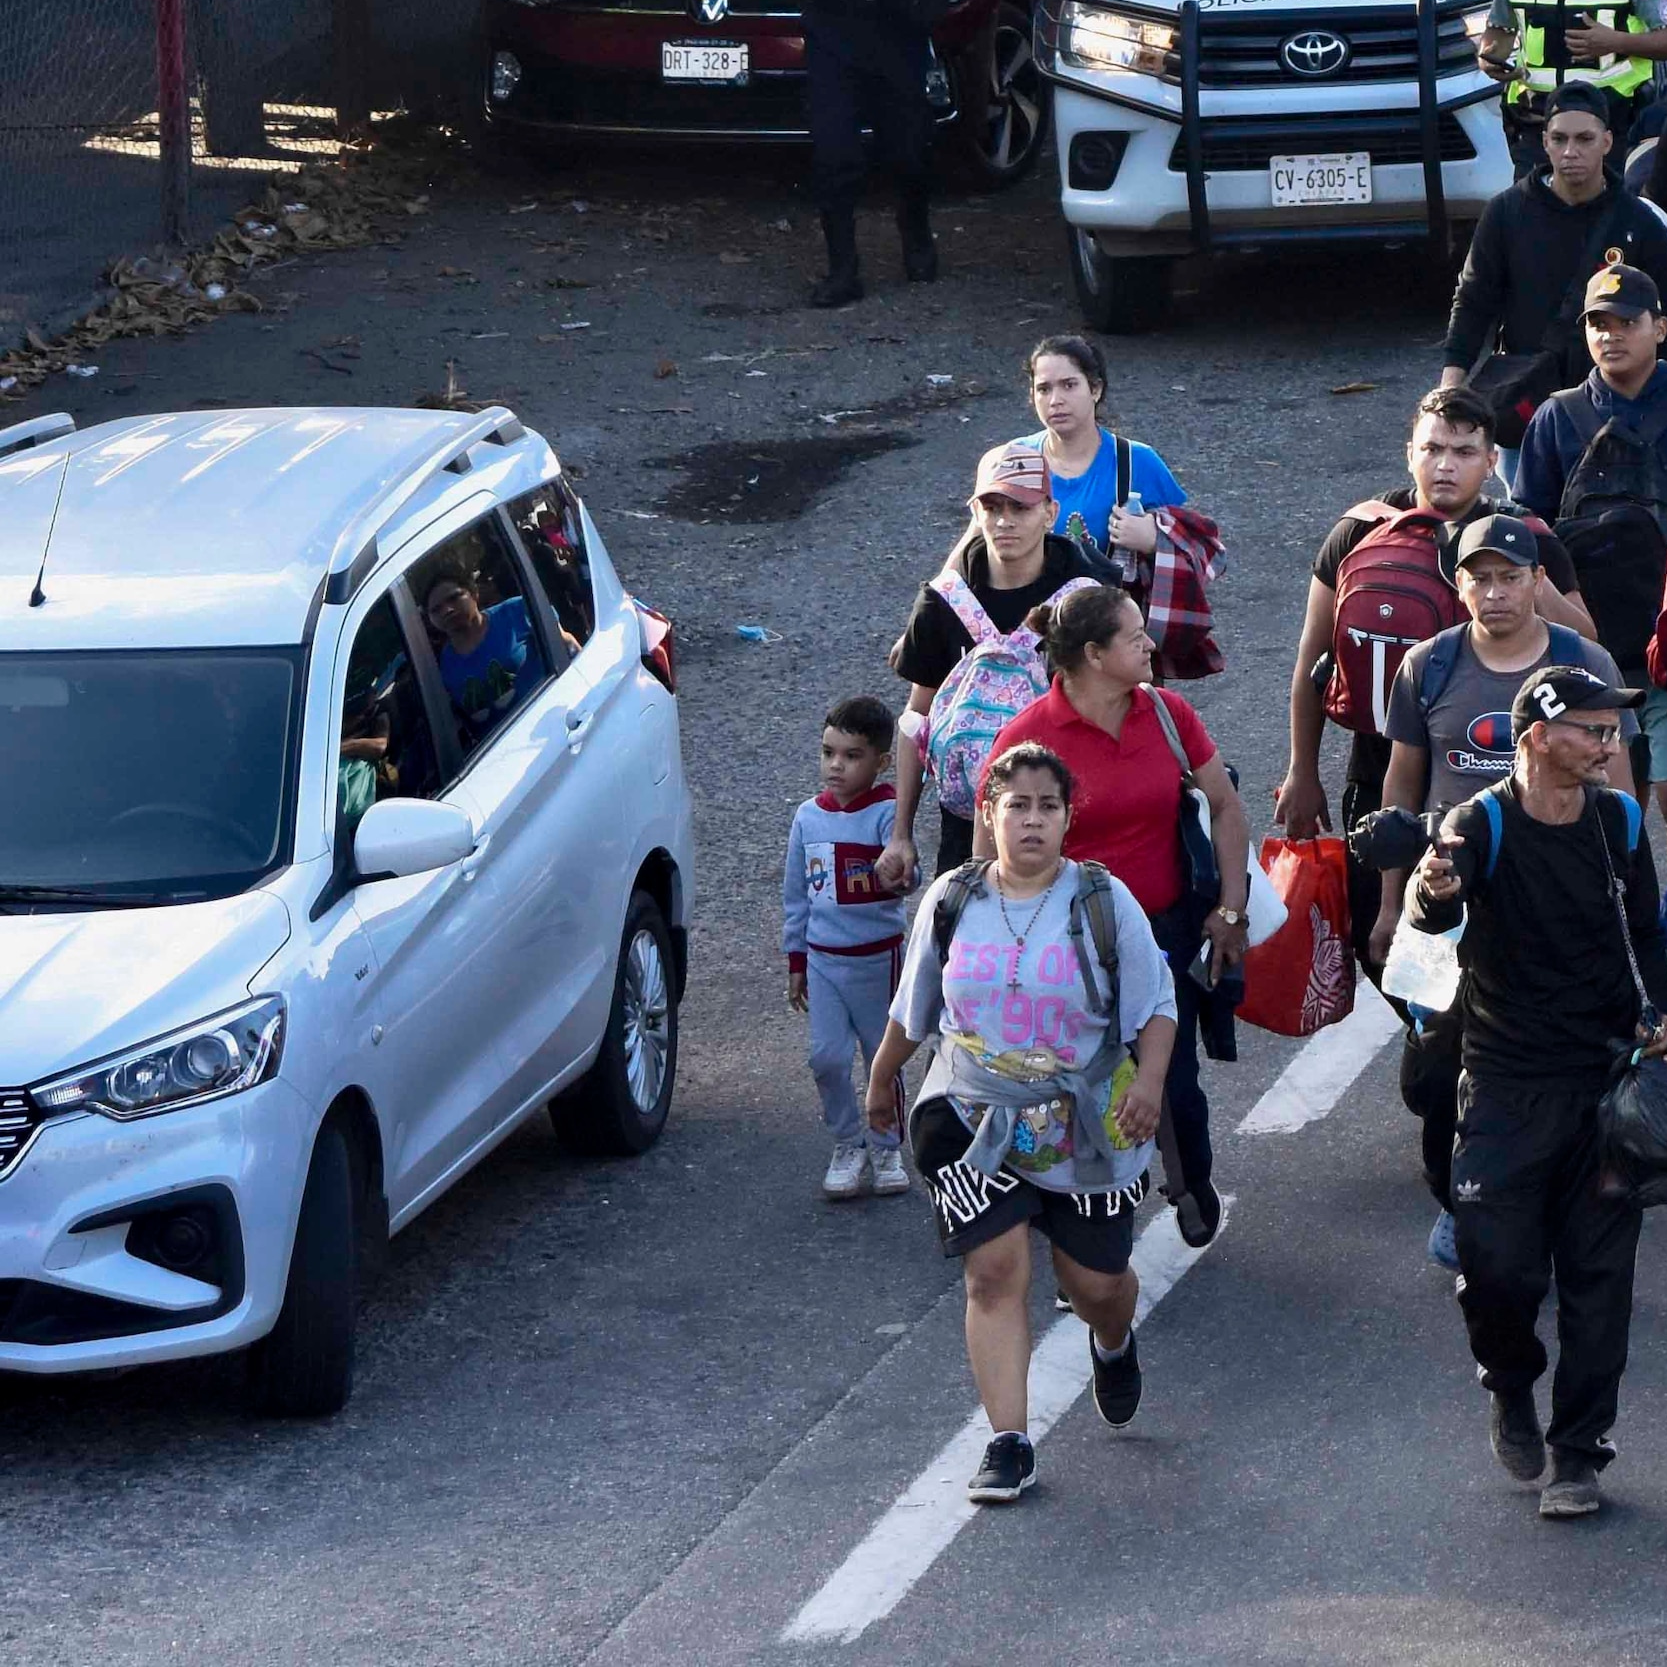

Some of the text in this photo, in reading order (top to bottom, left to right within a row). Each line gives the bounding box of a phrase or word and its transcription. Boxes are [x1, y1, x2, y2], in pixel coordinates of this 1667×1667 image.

[1275, 167, 1366, 190] CV-6305-E
[1532, 682, 1567, 720] 2
[952, 941, 1027, 982] EST
